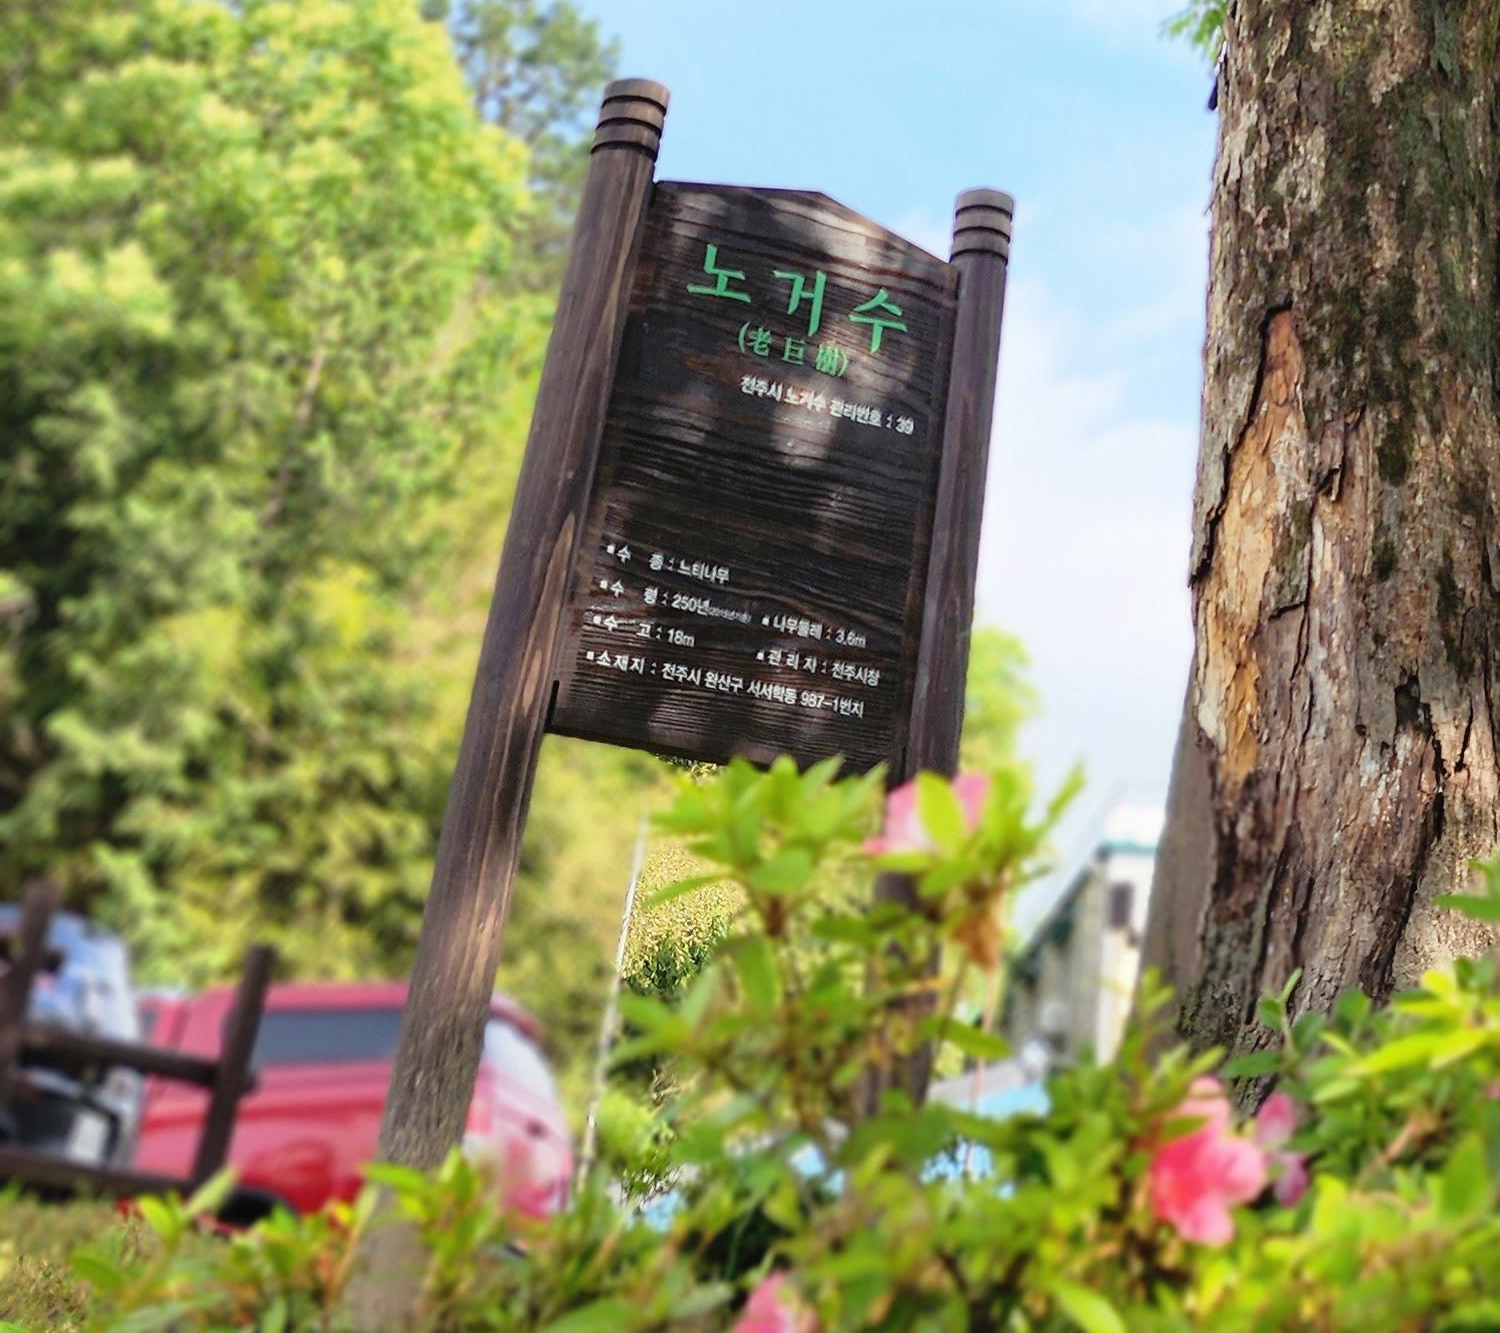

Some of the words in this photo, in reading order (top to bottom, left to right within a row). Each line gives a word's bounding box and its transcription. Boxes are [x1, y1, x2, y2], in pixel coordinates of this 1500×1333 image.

[686, 243, 909, 353] 노거수
[740, 374, 783, 402] 전주시
[784, 386, 827, 413] 노거수
[829, 398, 882, 428] 관리번호
[677, 558, 730, 584] 느티나무
[667, 628, 695, 648] 18m
[773, 614, 823, 641] 나무둘레
[835, 628, 867, 649] 3.6m
[596, 650, 645, 675] 소재지
[661, 662, 702, 686] 전주시
[704, 669, 744, 696] 완산구
[746, 679, 797, 706] 서서학동
[800, 689, 865, 719] 987-1번지
[831, 661, 881, 687] 전주시장
